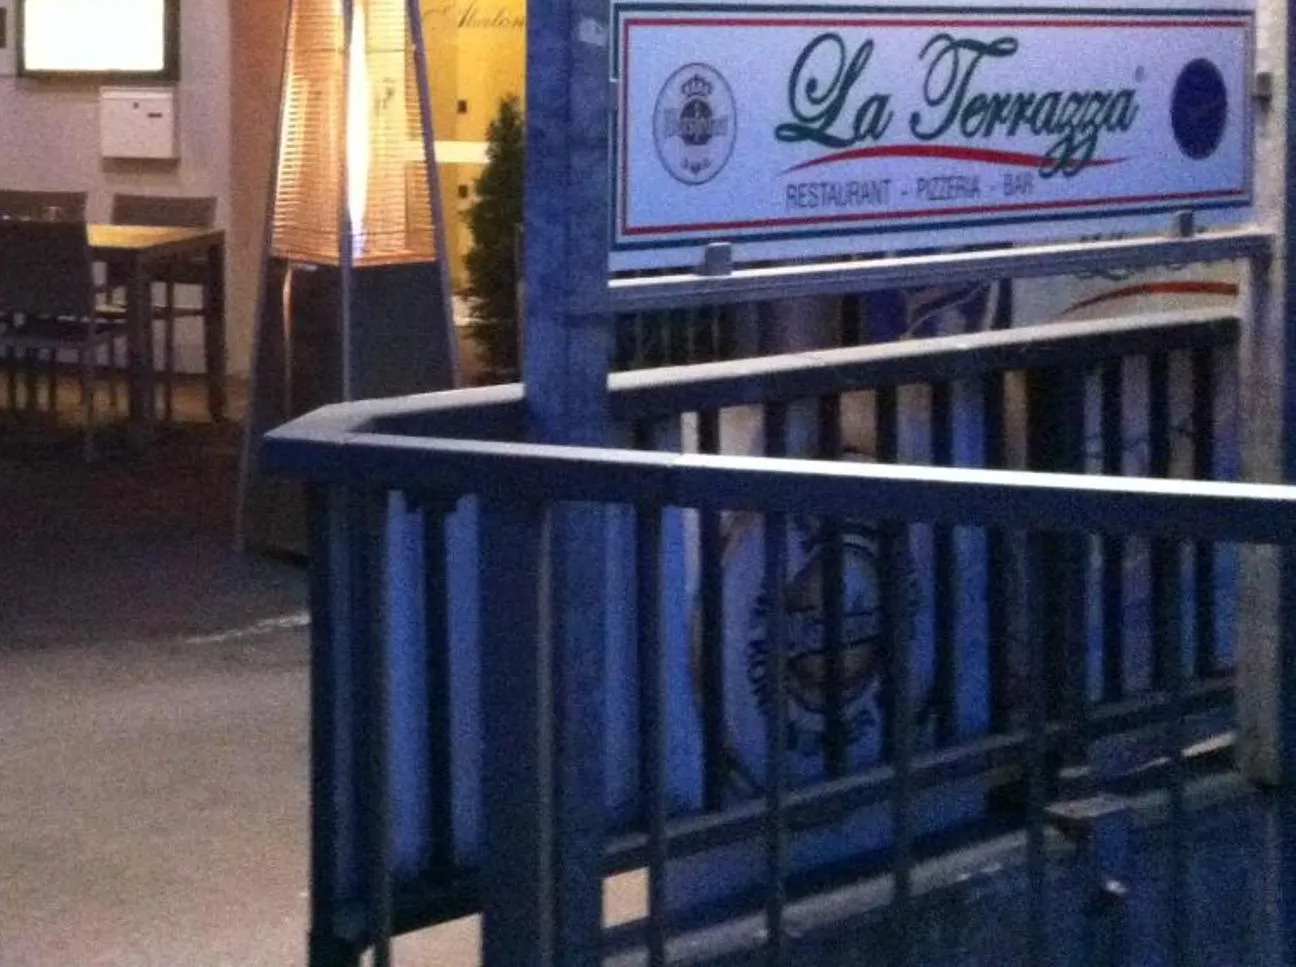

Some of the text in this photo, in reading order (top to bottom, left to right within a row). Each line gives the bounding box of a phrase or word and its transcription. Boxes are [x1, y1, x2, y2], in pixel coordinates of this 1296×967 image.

[774, 32, 1140, 179] La Terrazza
[786, 178, 892, 209] RESTAURANT
[916, 175, 981, 201] PIZZERIA
[1004, 172, 1035, 196] BAR
